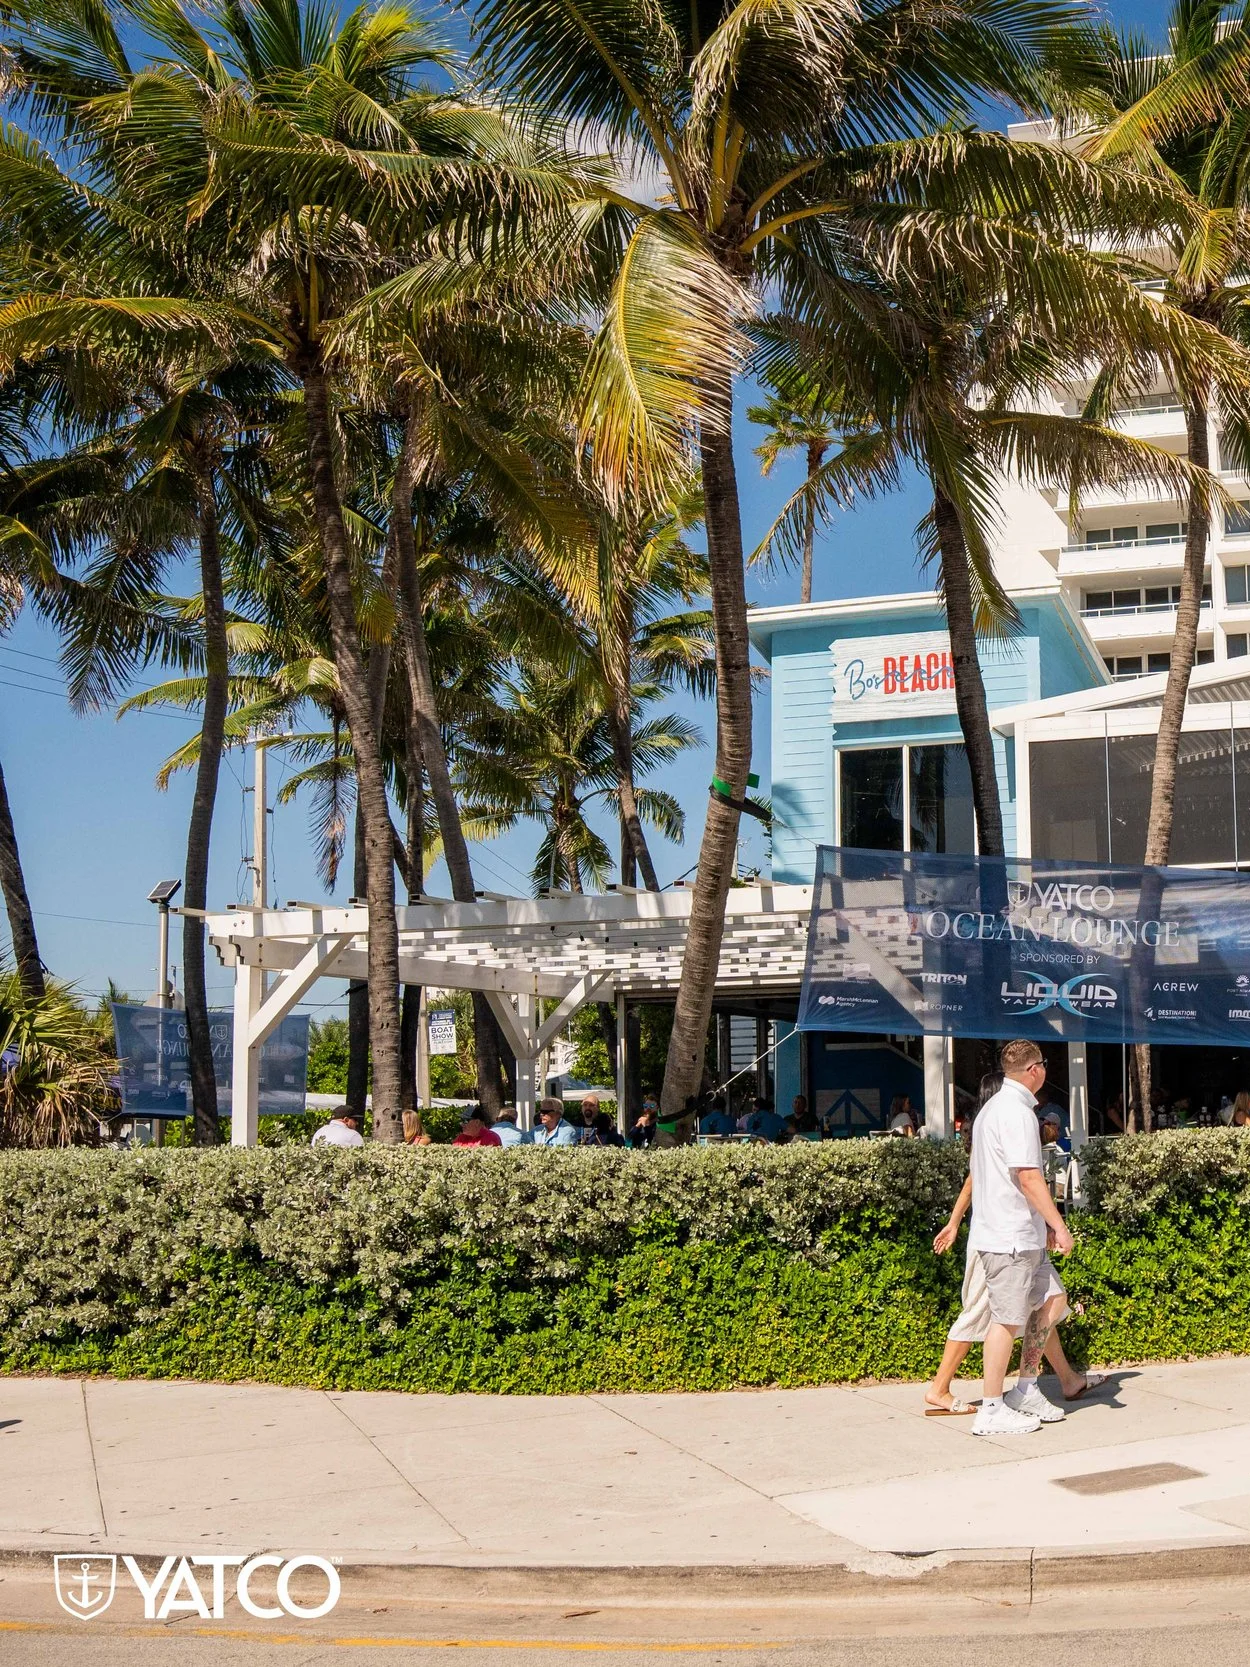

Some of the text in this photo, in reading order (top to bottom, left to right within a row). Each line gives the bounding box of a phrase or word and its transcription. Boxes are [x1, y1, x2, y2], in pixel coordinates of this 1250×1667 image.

[844, 659, 882, 700] Bo's
[1033, 882, 1115, 912] YATCO
[926, 911, 1181, 948] OCEAN LOUNGE
[1019, 952, 1101, 966] SPONSORED BY
[920, 973, 967, 985] TRITON
[1001, 982, 1117, 1001] LIQUID
[1153, 982, 1199, 993] ACREW
[930, 1003, 963, 1012] ROPNER
[1001, 998, 1116, 1009] YACHT WEAR
[431, 1026, 453, 1034] BOAT
